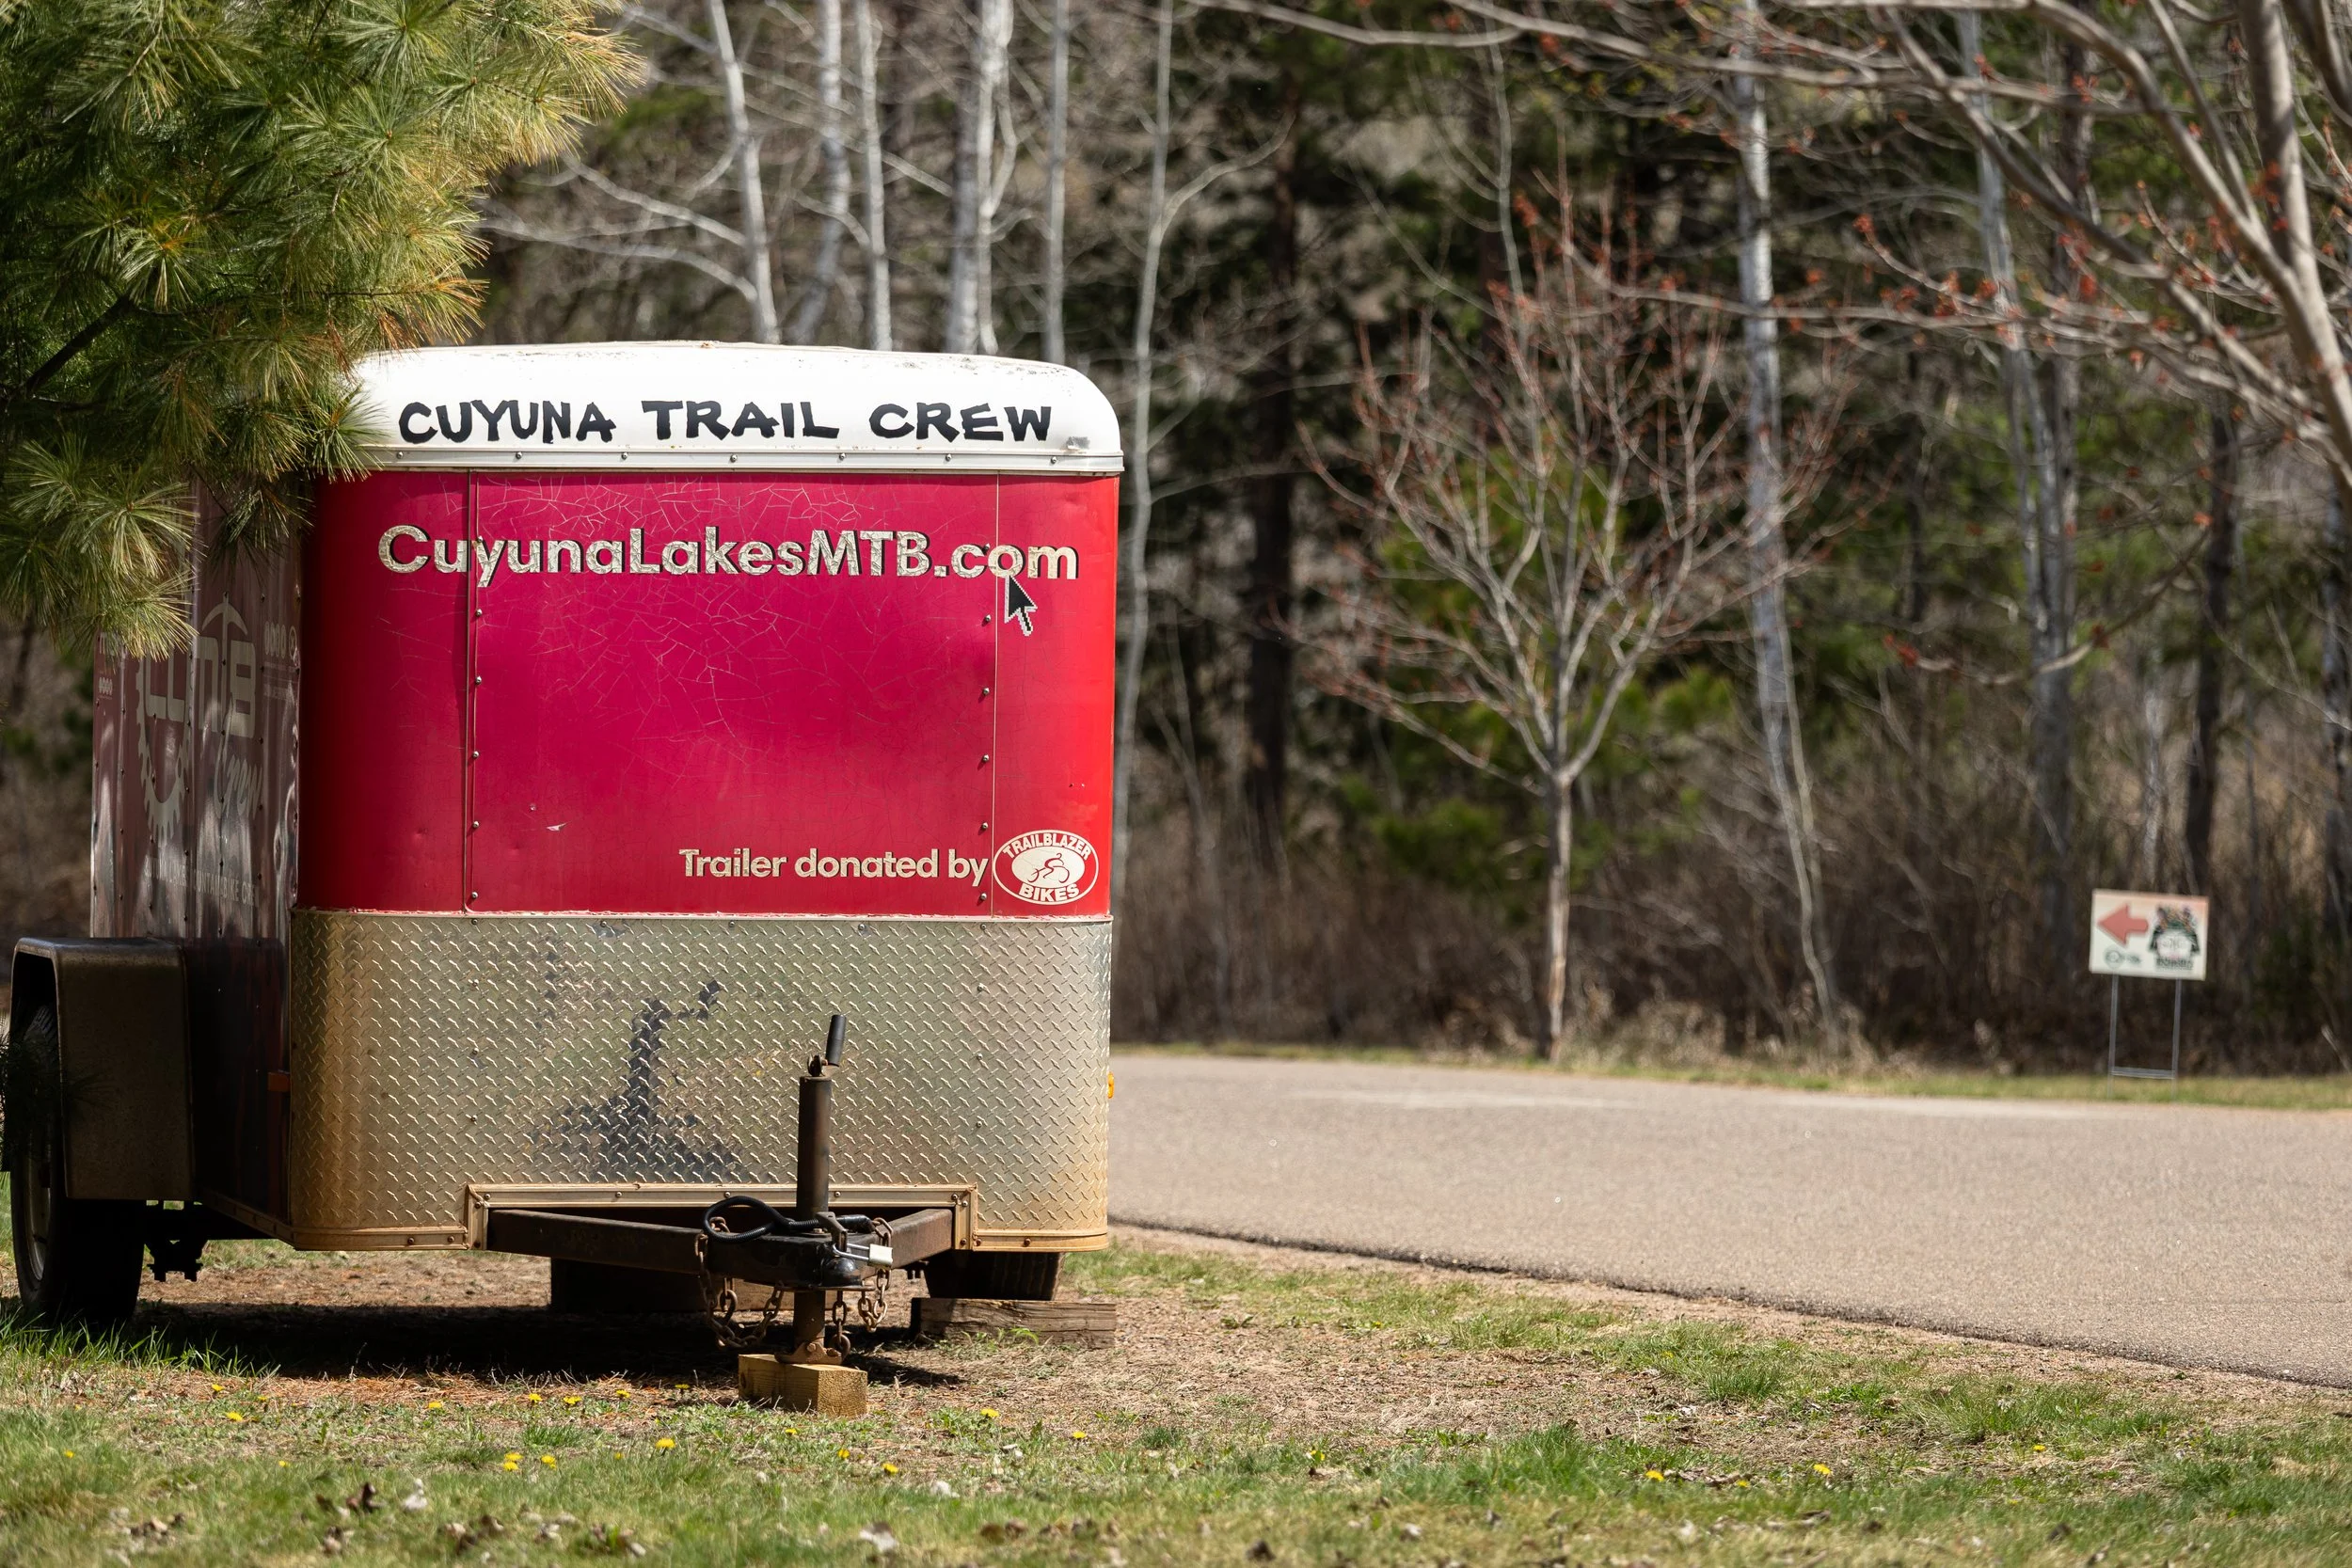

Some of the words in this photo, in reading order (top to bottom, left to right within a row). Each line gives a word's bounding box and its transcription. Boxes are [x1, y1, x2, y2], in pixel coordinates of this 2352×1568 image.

[398, 399, 615, 444] CUYUNA
[642, 399, 839, 442] TRAIL
[868, 401, 1054, 443] CREW
[377, 524, 1079, 588] CuyunaLakesMTB.com
[1002, 832, 1092, 861] TRAILBLAZER
[678, 847, 787, 879] Trailer
[794, 847, 939, 879] donated
[948, 847, 990, 887] by
[1018, 882, 1080, 902] BIKES
